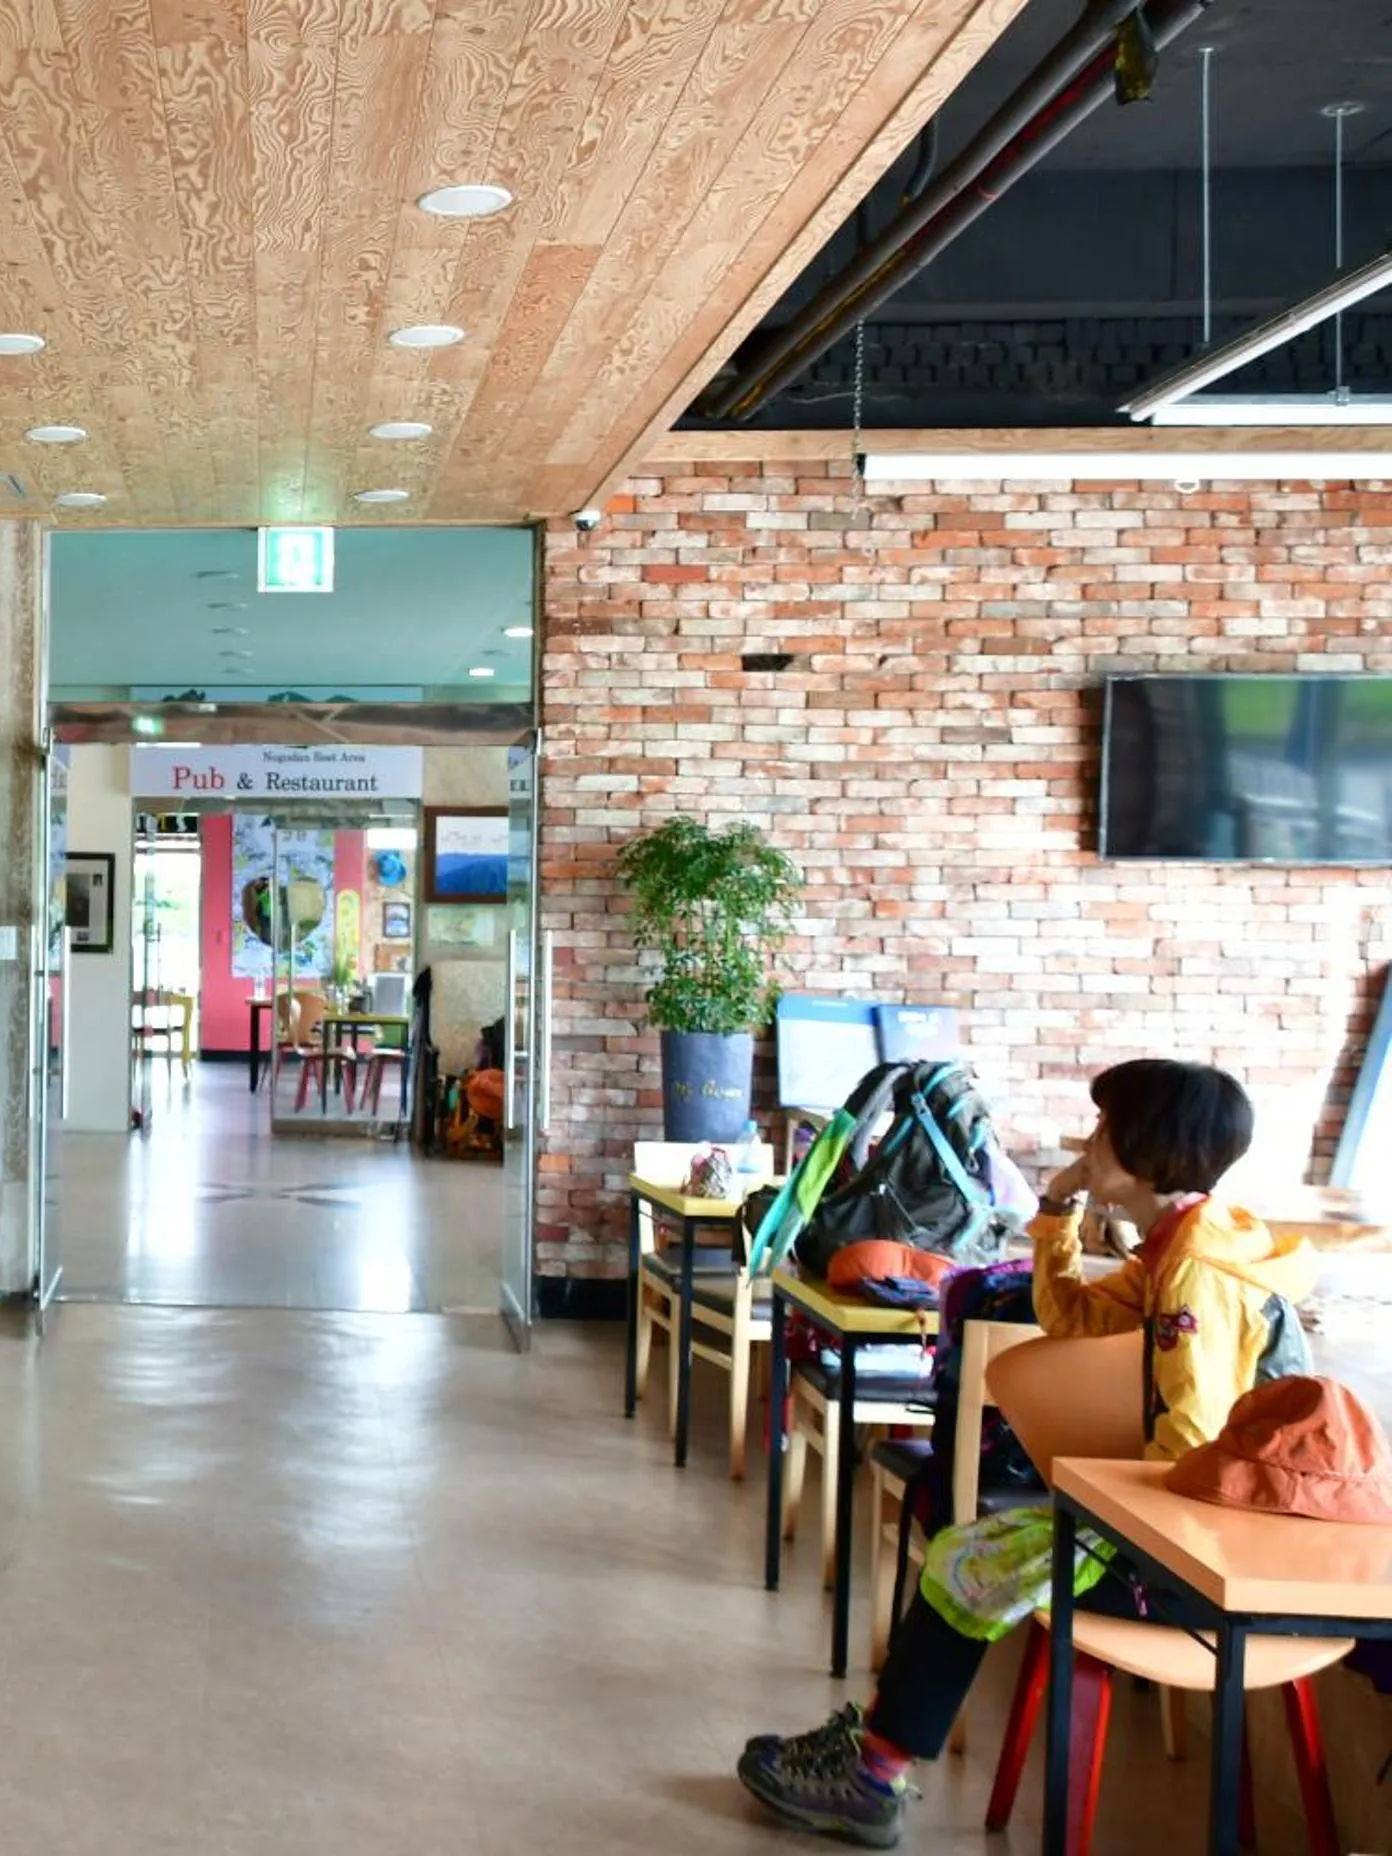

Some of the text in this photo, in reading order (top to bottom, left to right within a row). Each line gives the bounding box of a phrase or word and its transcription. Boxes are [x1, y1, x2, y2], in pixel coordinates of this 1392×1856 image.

[340, 751, 366, 762] Area
[171, 766, 378, 792] Pub & Restaurant
